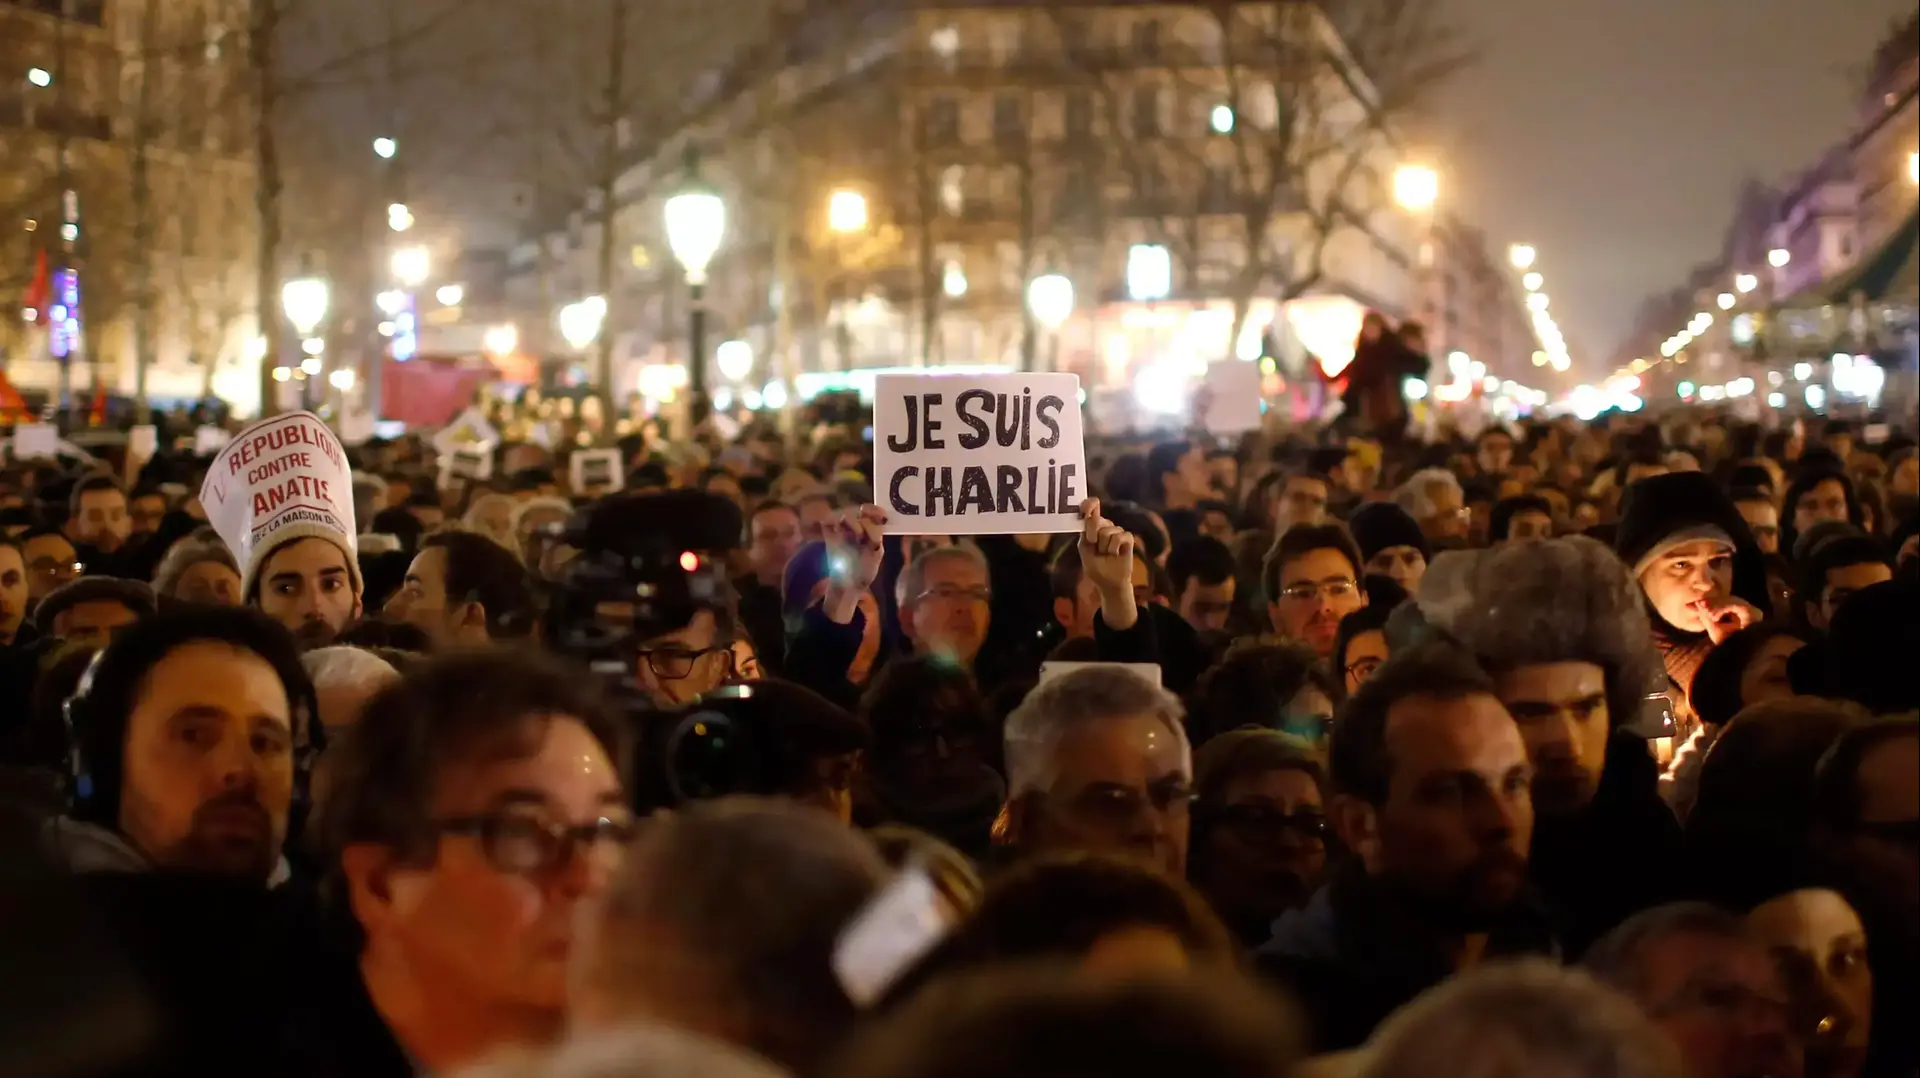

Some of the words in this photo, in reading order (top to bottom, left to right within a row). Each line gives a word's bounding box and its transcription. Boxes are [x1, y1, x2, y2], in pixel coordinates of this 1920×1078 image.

[887, 393, 945, 453] JE
[248, 452, 312, 485] CONTRE
[269, 520, 280, 532] LA
[282, 510, 322, 525] MAISON
